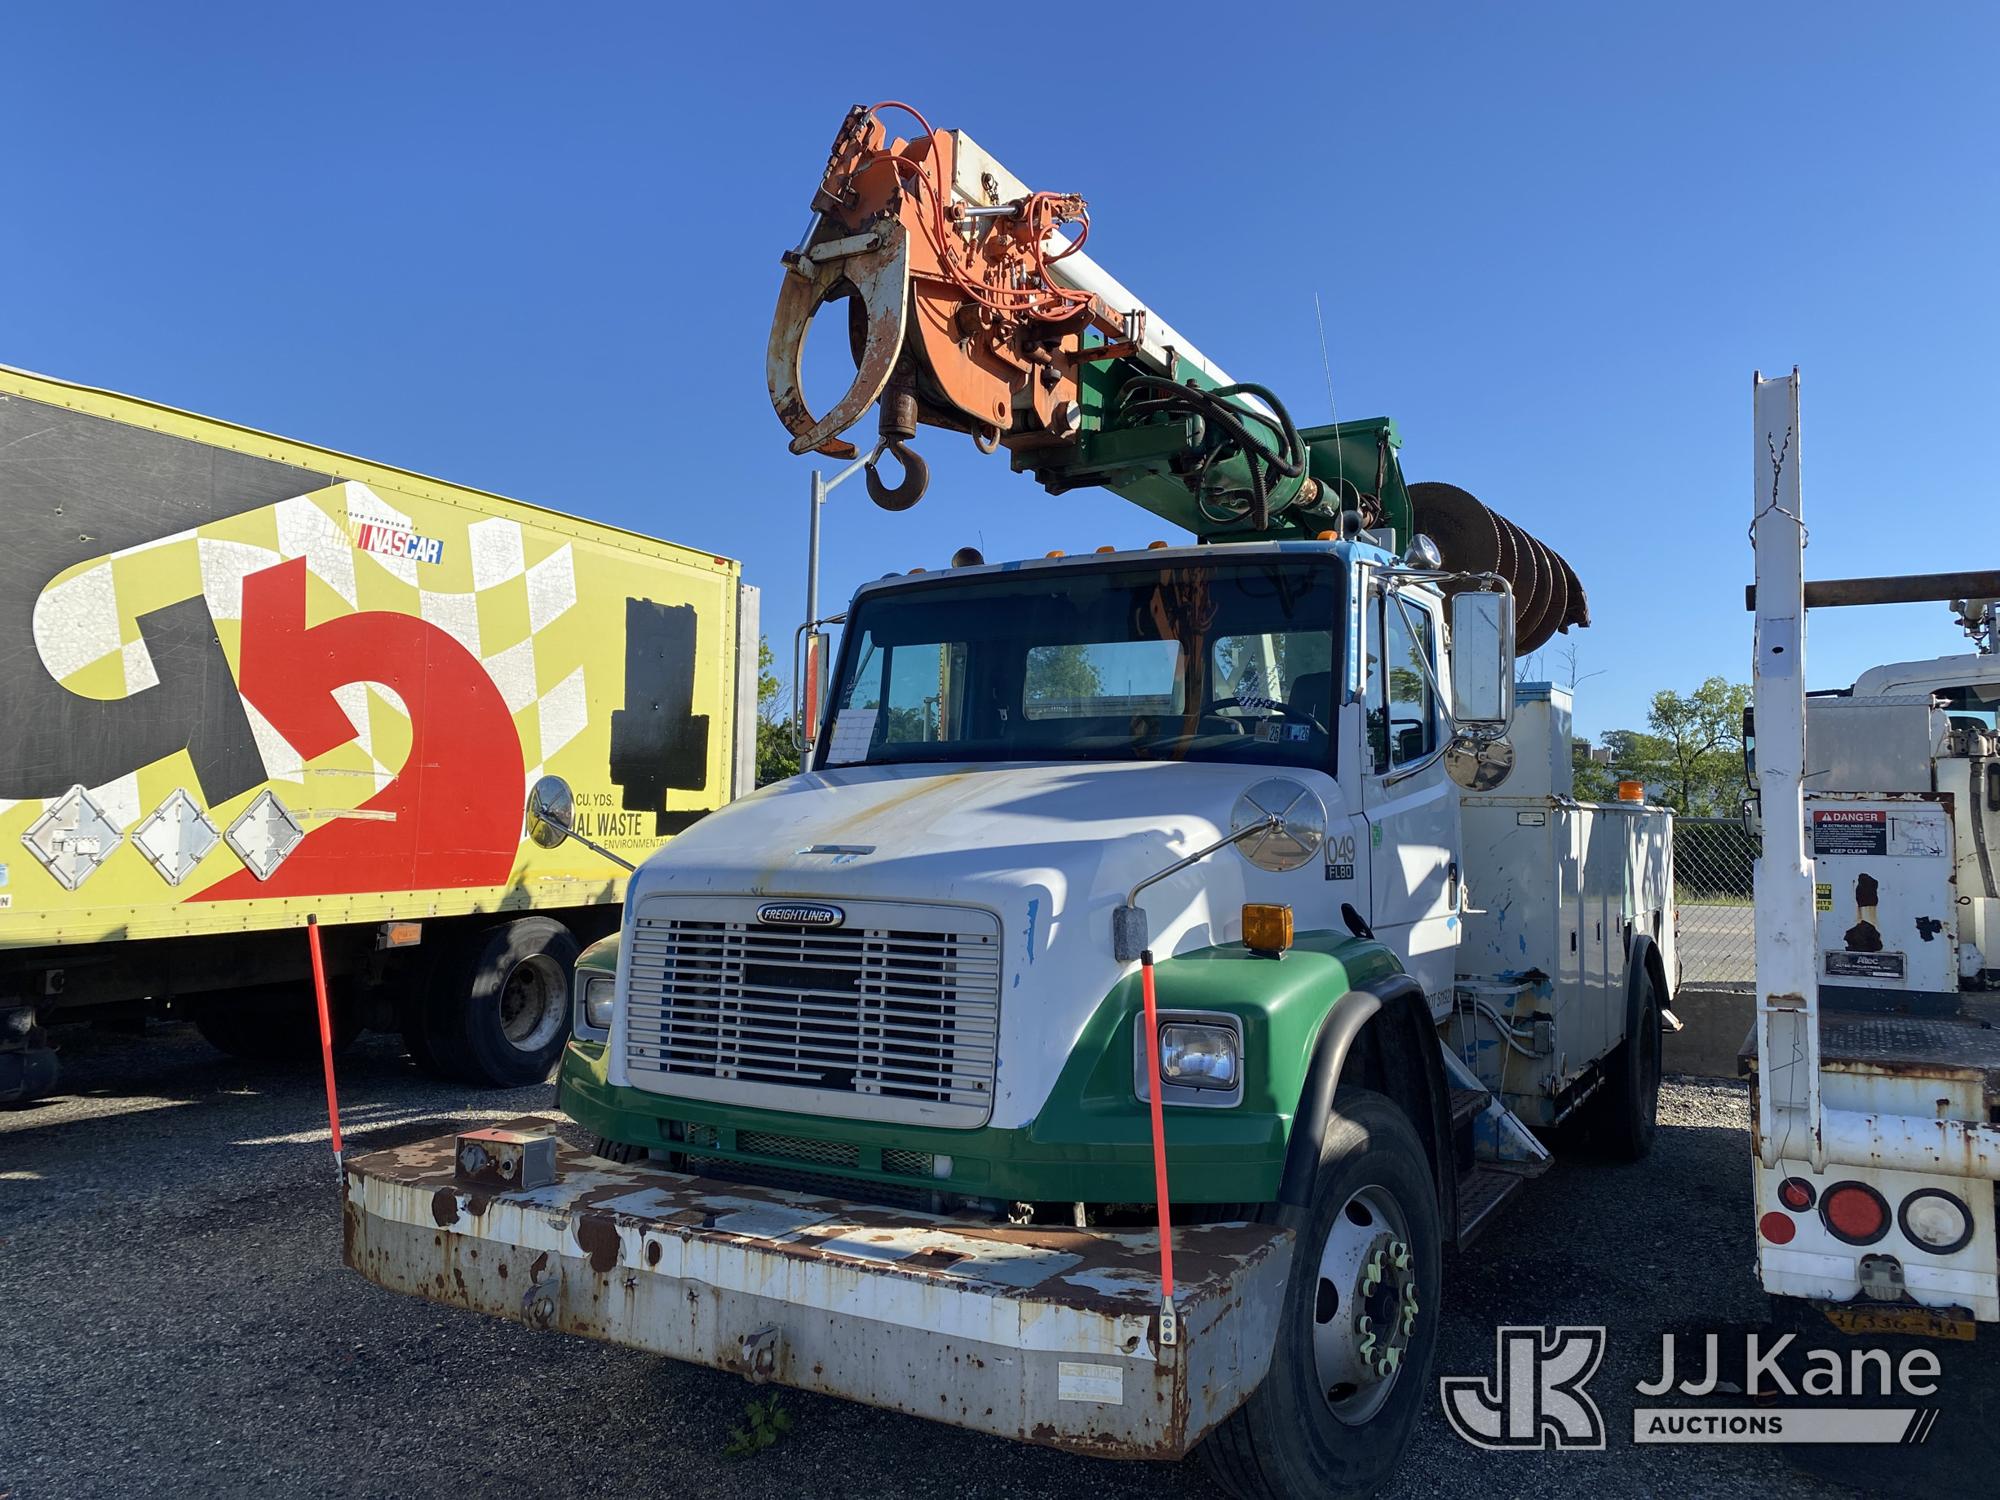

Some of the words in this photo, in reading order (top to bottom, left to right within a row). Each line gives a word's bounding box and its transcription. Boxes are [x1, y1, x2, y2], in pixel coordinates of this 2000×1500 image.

[367, 526, 440, 564] NASCAR
[576, 793, 591, 806] CU.
[593, 793, 615, 806] YDS.
[1833, 813, 1878, 821] DANGER
[597, 812, 642, 837] WASTE
[1329, 866, 1352, 879] FL80
[764, 908, 831, 922] FREIGHTLINER
[1856, 955, 1879, 965] Altec
